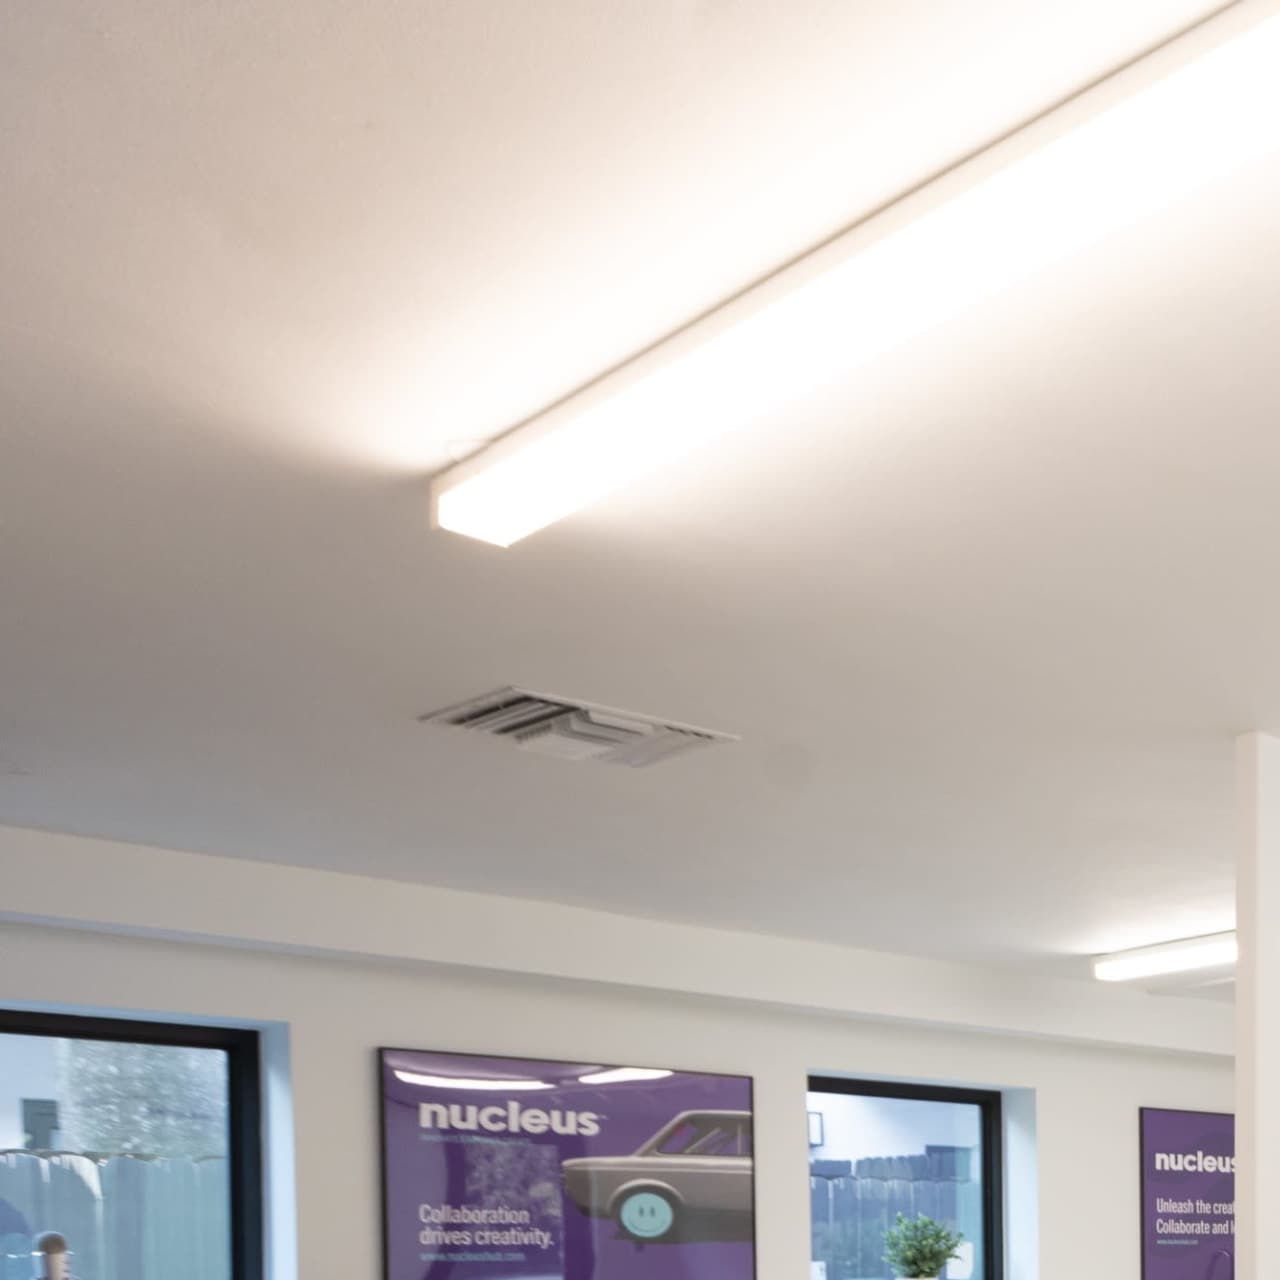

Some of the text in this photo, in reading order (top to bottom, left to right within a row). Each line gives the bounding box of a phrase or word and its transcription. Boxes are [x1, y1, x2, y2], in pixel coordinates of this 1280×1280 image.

[419, 1100, 600, 1136] nucleus
[419, 1203, 530, 1224] Collaboration
[1156, 1197, 1194, 1214] Unleash
[1196, 1199, 1211, 1214] the
[419, 1225, 555, 1249] drives creativity.
[1156, 1218, 1210, 1235] Collaborate
[1212, 1220, 1229, 1235] and
